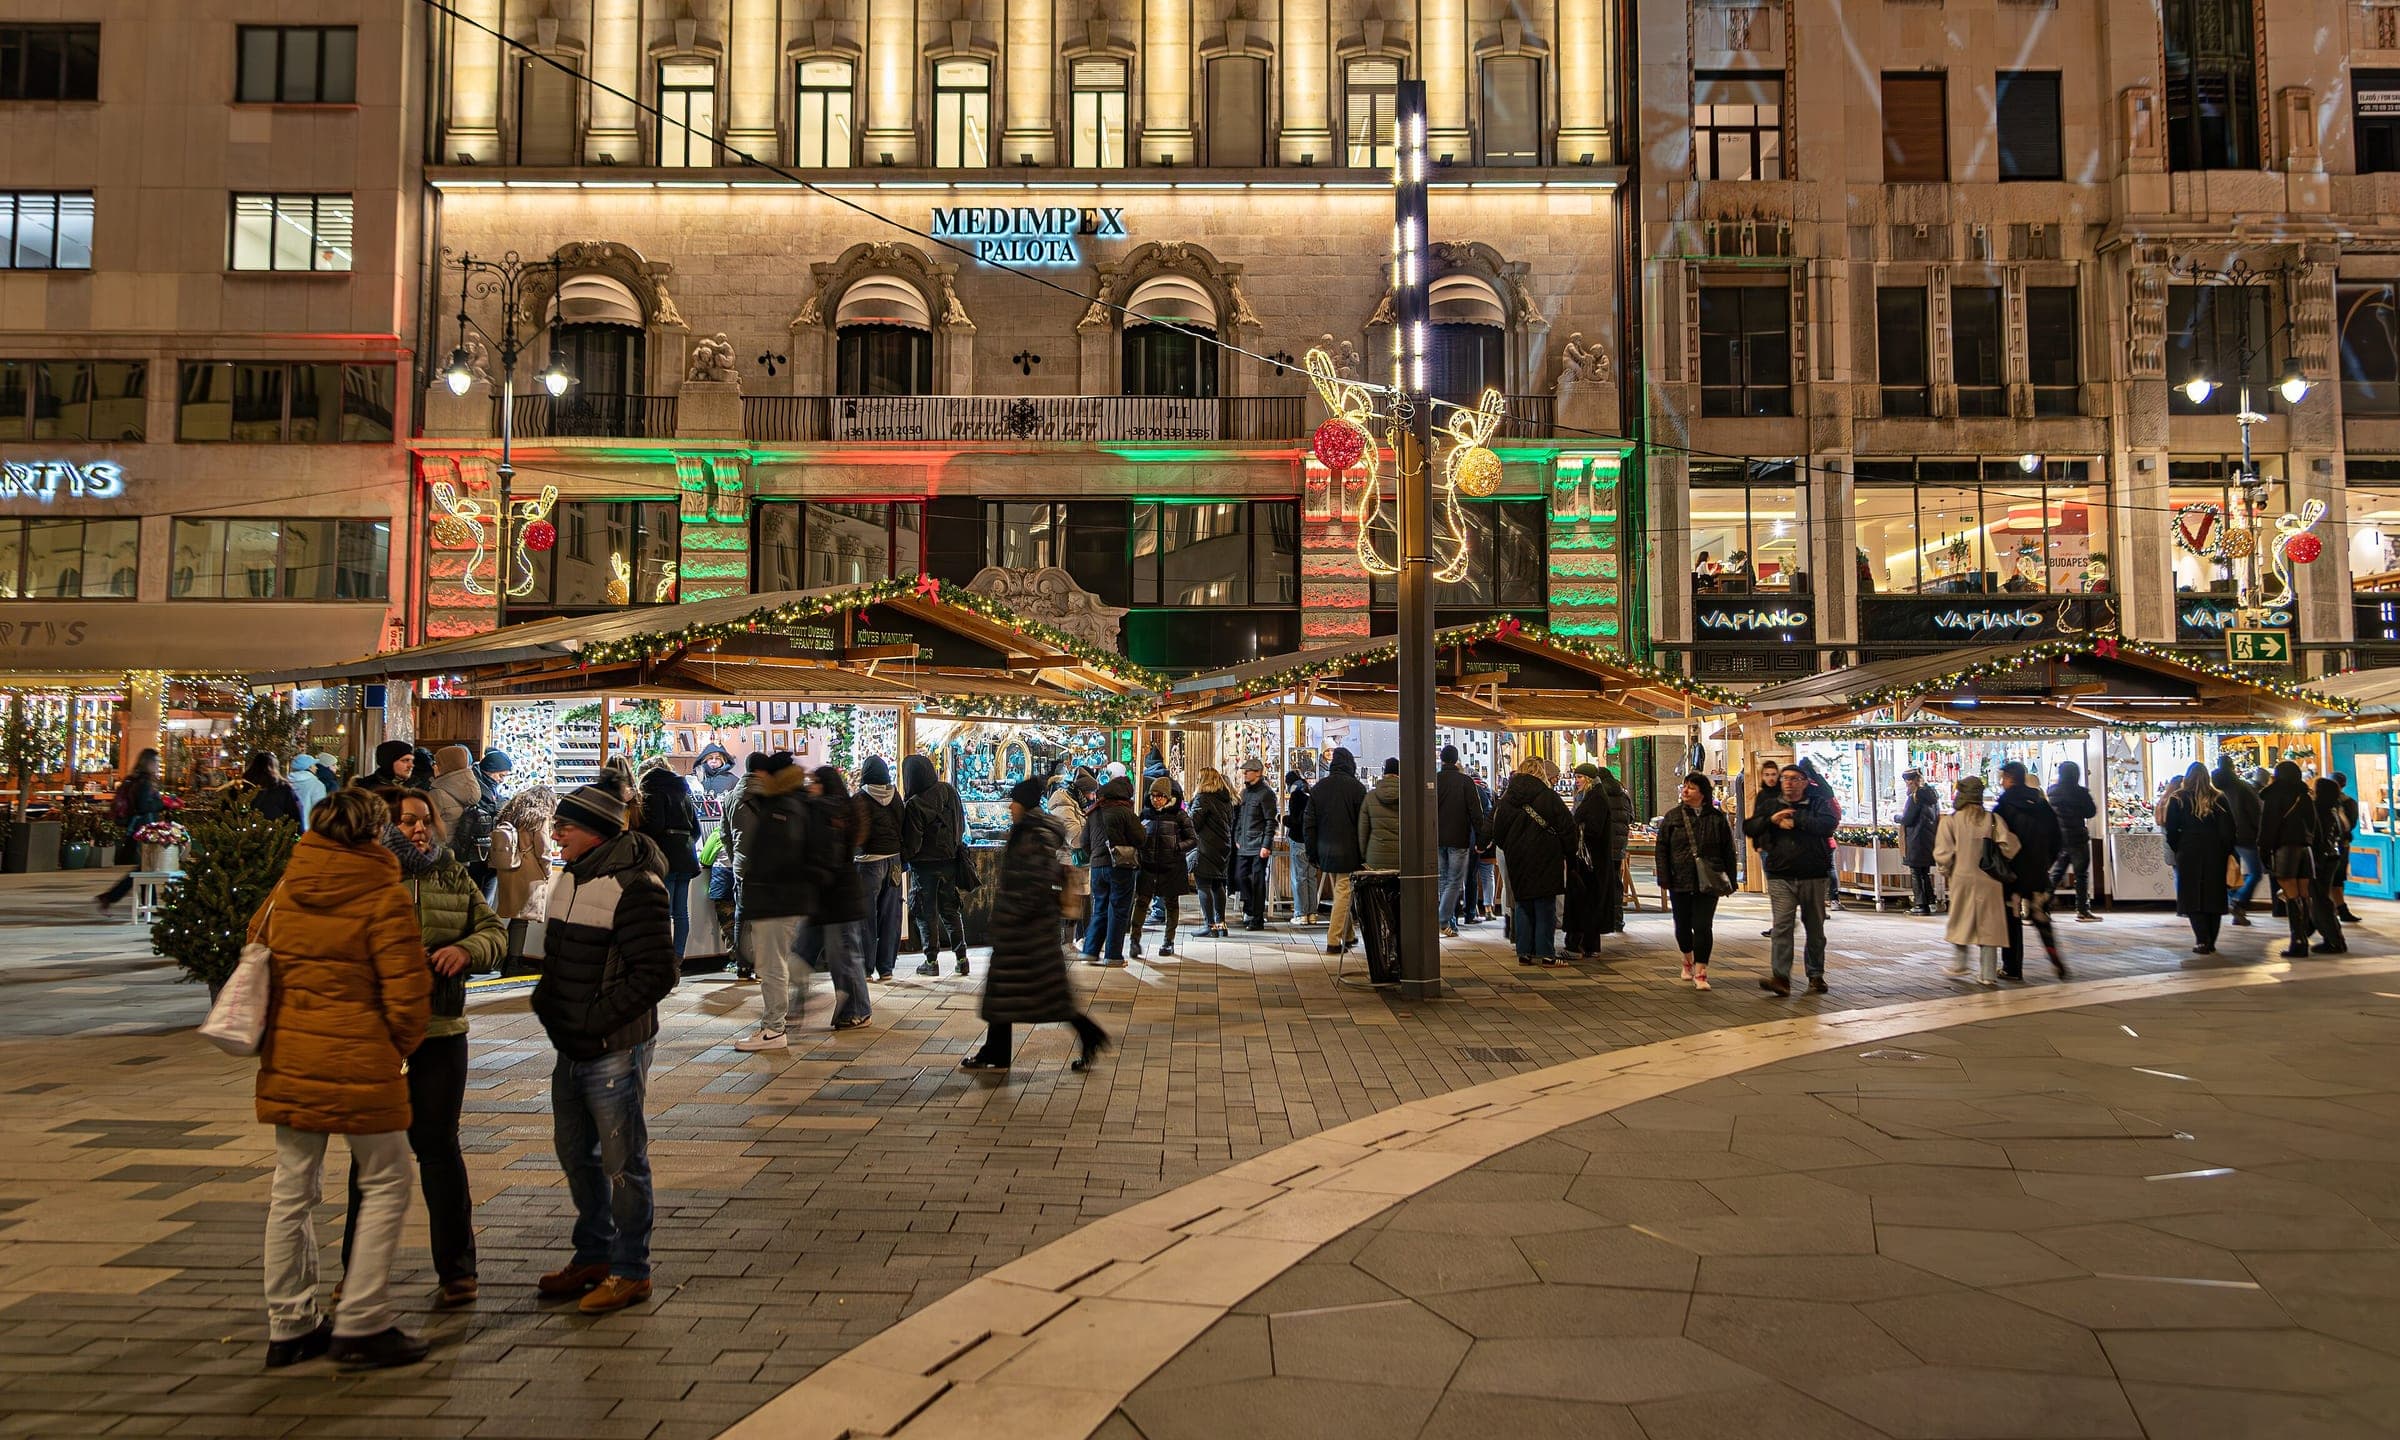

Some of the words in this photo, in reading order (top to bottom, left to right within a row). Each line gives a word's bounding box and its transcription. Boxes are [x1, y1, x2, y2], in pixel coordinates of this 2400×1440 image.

[931, 207, 1125, 235] MEDIMPEX
[979, 239, 1077, 262] PALOTA
[1166, 406, 1191, 420] JLL
[896, 425, 922, 436] 2050
[857, 629, 880, 643] KÖVES
[790, 637, 814, 649] TIFFANY
[814, 639, 834, 651] GLASS
[1496, 662, 1521, 674] LEATHER
